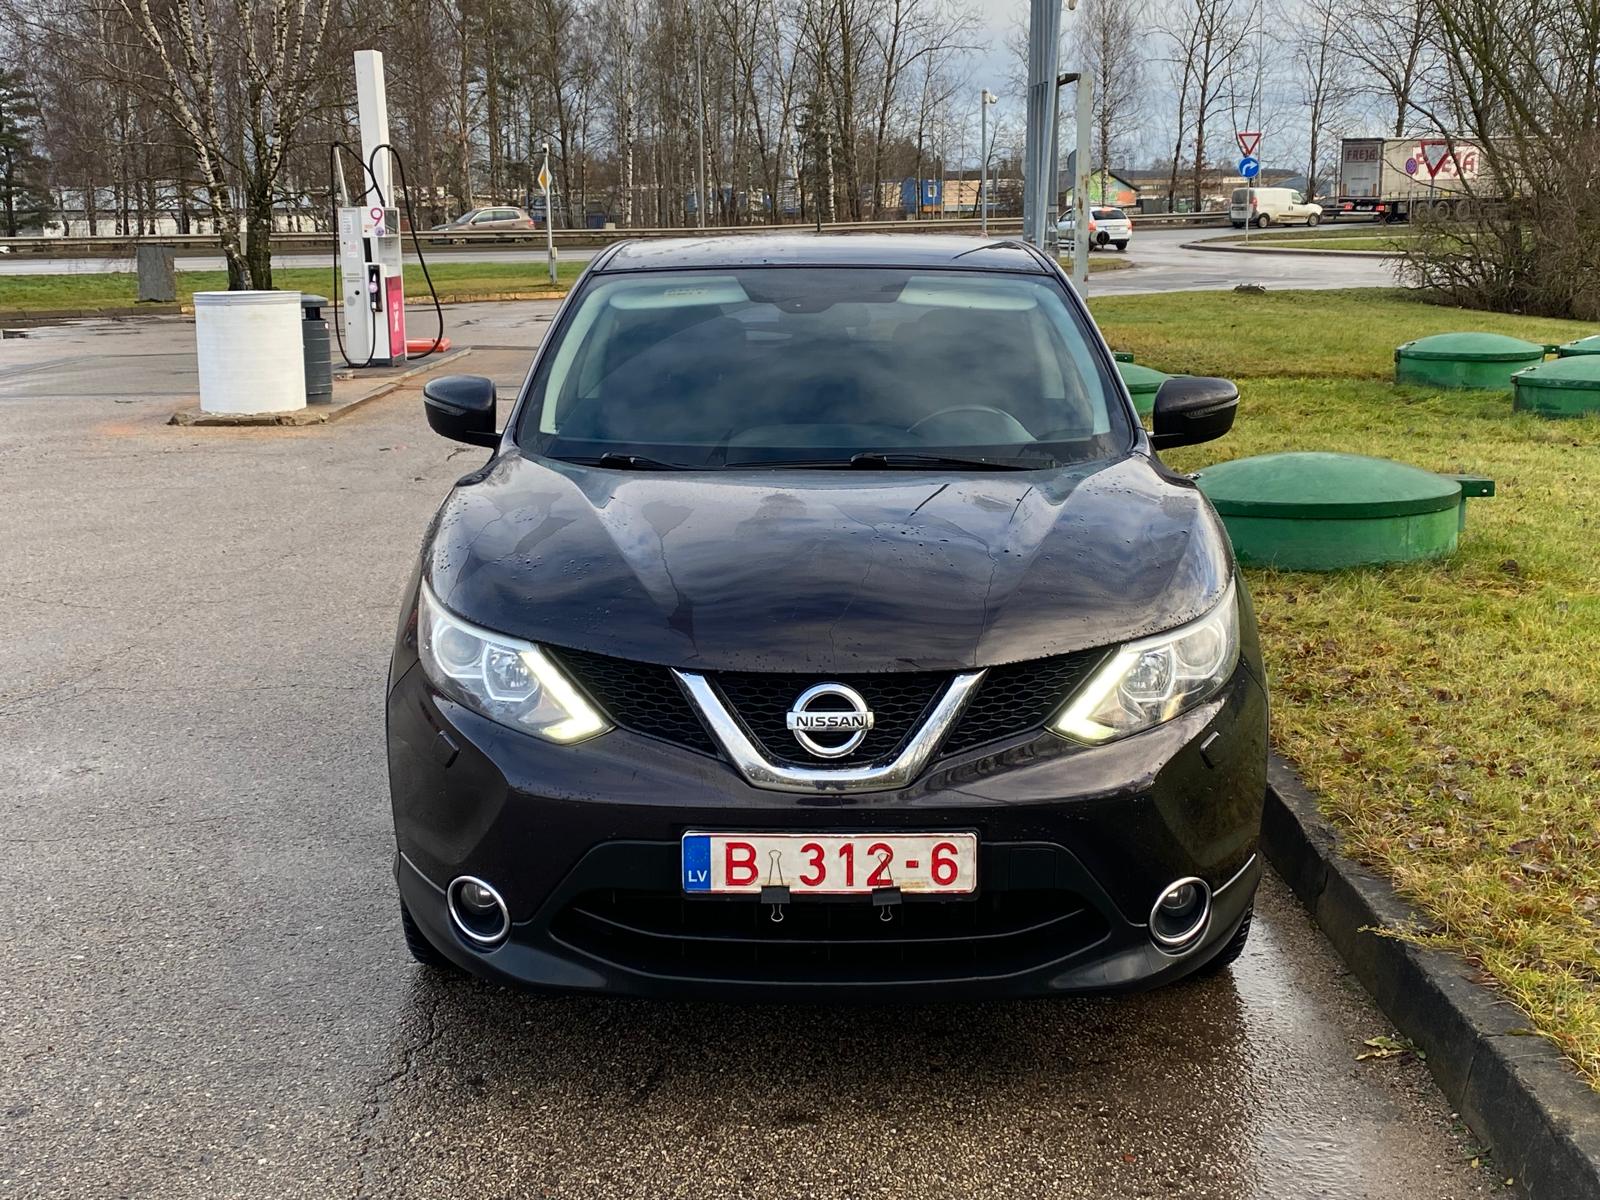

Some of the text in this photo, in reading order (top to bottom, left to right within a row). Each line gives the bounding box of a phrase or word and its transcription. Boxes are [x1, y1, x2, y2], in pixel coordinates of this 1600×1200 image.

[370, 207, 383, 227] 9
[796, 715, 864, 727] NISSAN
[725, 842, 959, 886] B 312-6
[688, 870, 708, 882] LV
